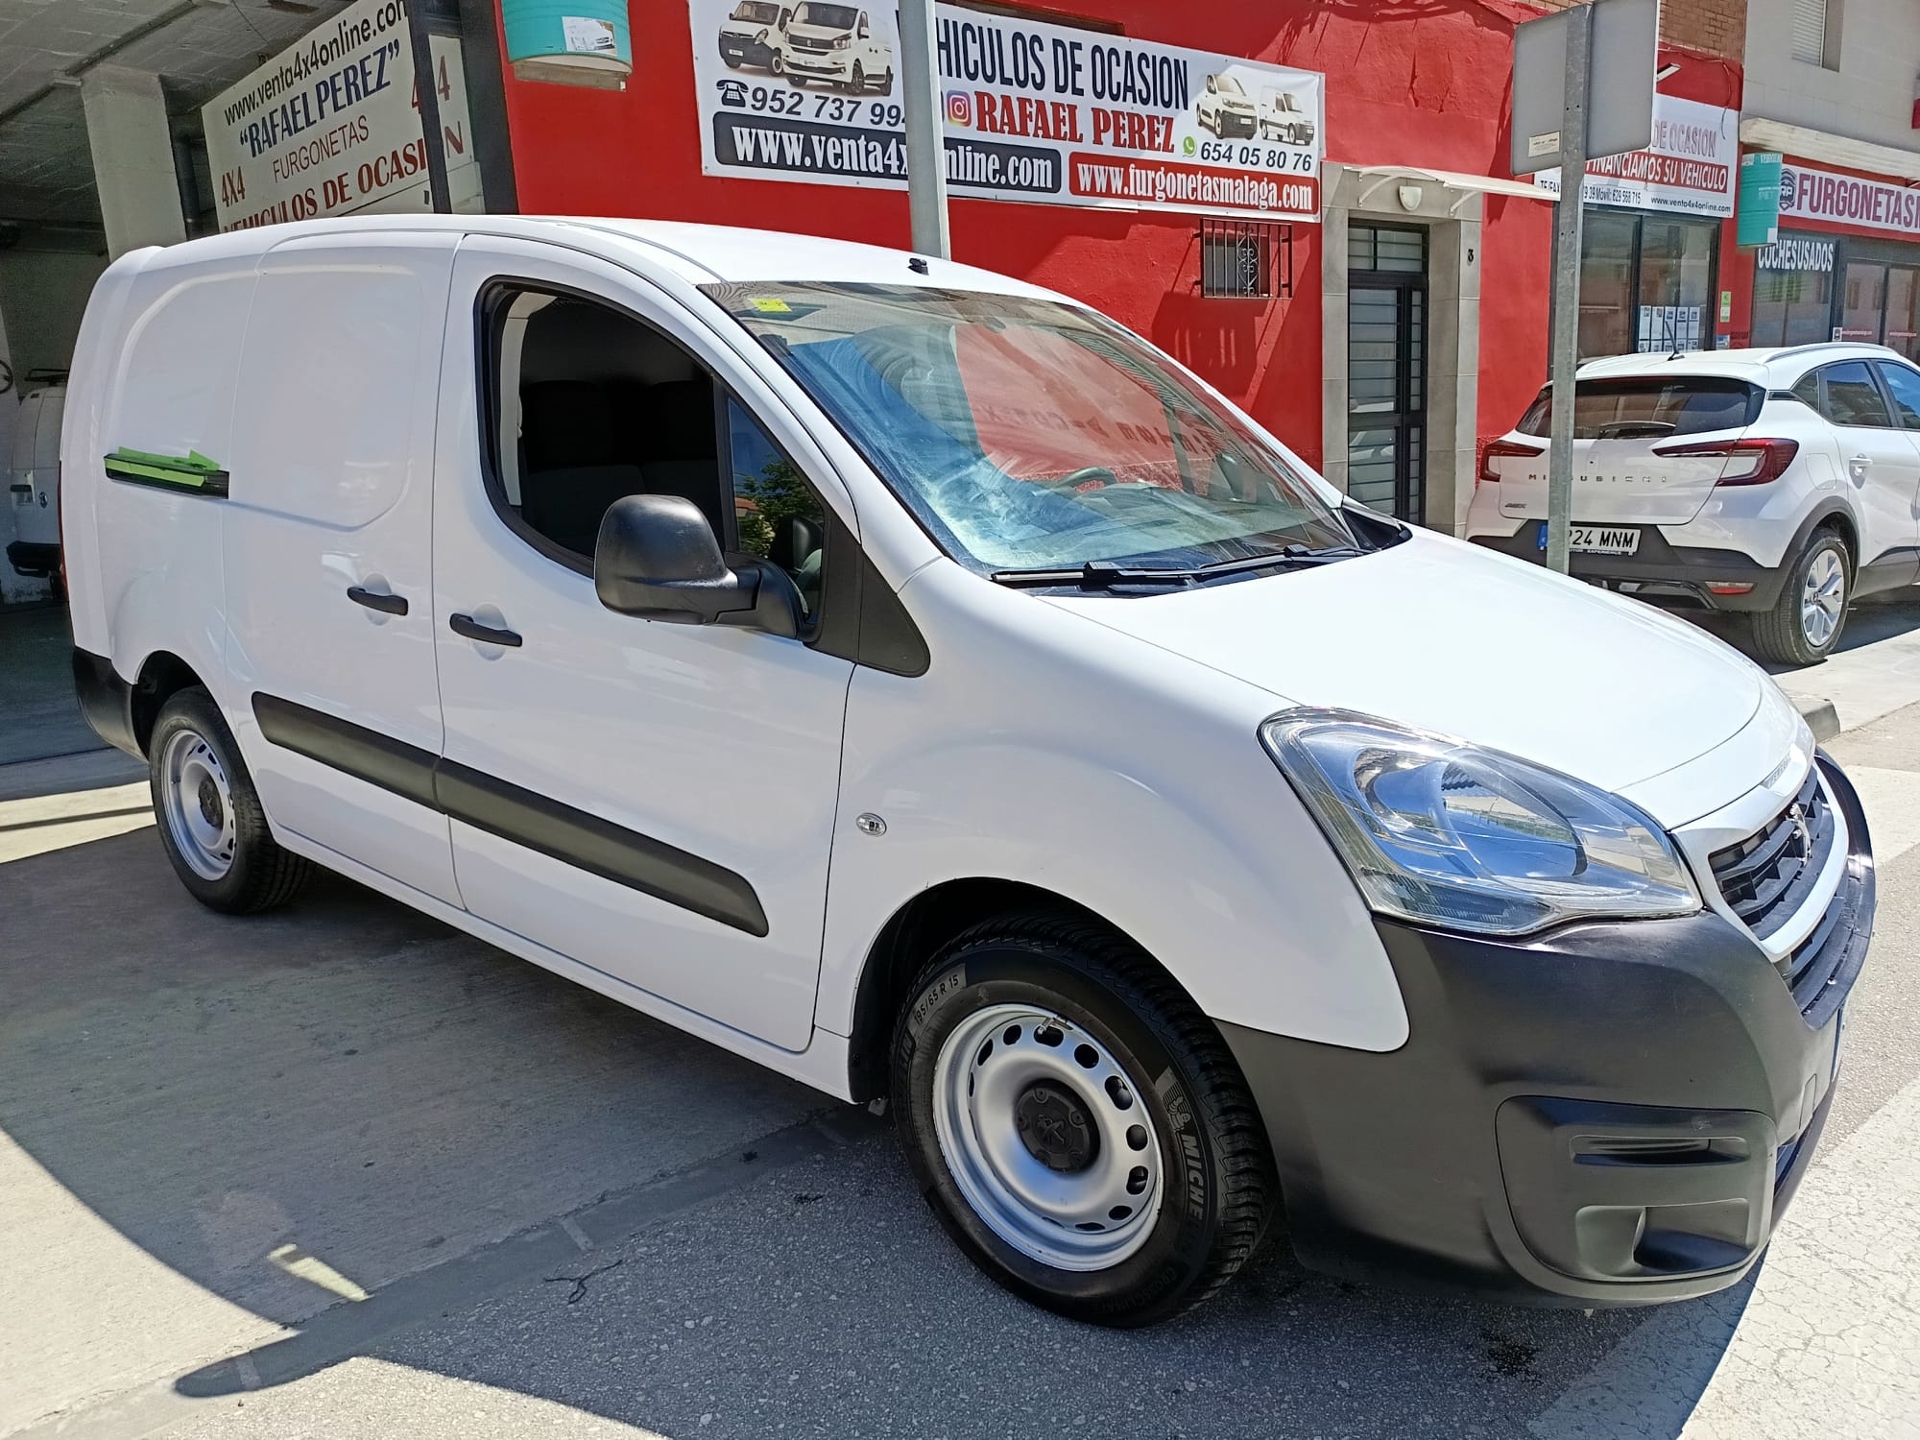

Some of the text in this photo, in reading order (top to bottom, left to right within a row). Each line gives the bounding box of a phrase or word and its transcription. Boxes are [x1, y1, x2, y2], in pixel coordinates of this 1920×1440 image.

[895, 10, 1189, 111] HICULOS DE OCASION
[750, 86, 906, 128] 952 737 99
[974, 90, 1175, 154] RAFAEL PEREZ
[272, 114, 370, 184] FURGONETAS
[732, 125, 1053, 189] www.venta4xnline.com
[1200, 141, 1312, 171] 654 05 80 76
[1652, 119, 1717, 158] DE OCASION
[220, 165, 246, 208] 4X4
[322, 172, 353, 210] DE
[1077, 161, 1313, 211] www.furgonetasmalaga.com
[1663, 161, 1677, 182] SU
[1680, 161, 1727, 191] VEHICULO
[1467, 248, 1474, 262] 3
[1528, 474, 1667, 483] MIUBISHI
[1599, 530, 1635, 548] MNM
[940, 982, 947, 996] R
[949, 974, 959, 989] 15
